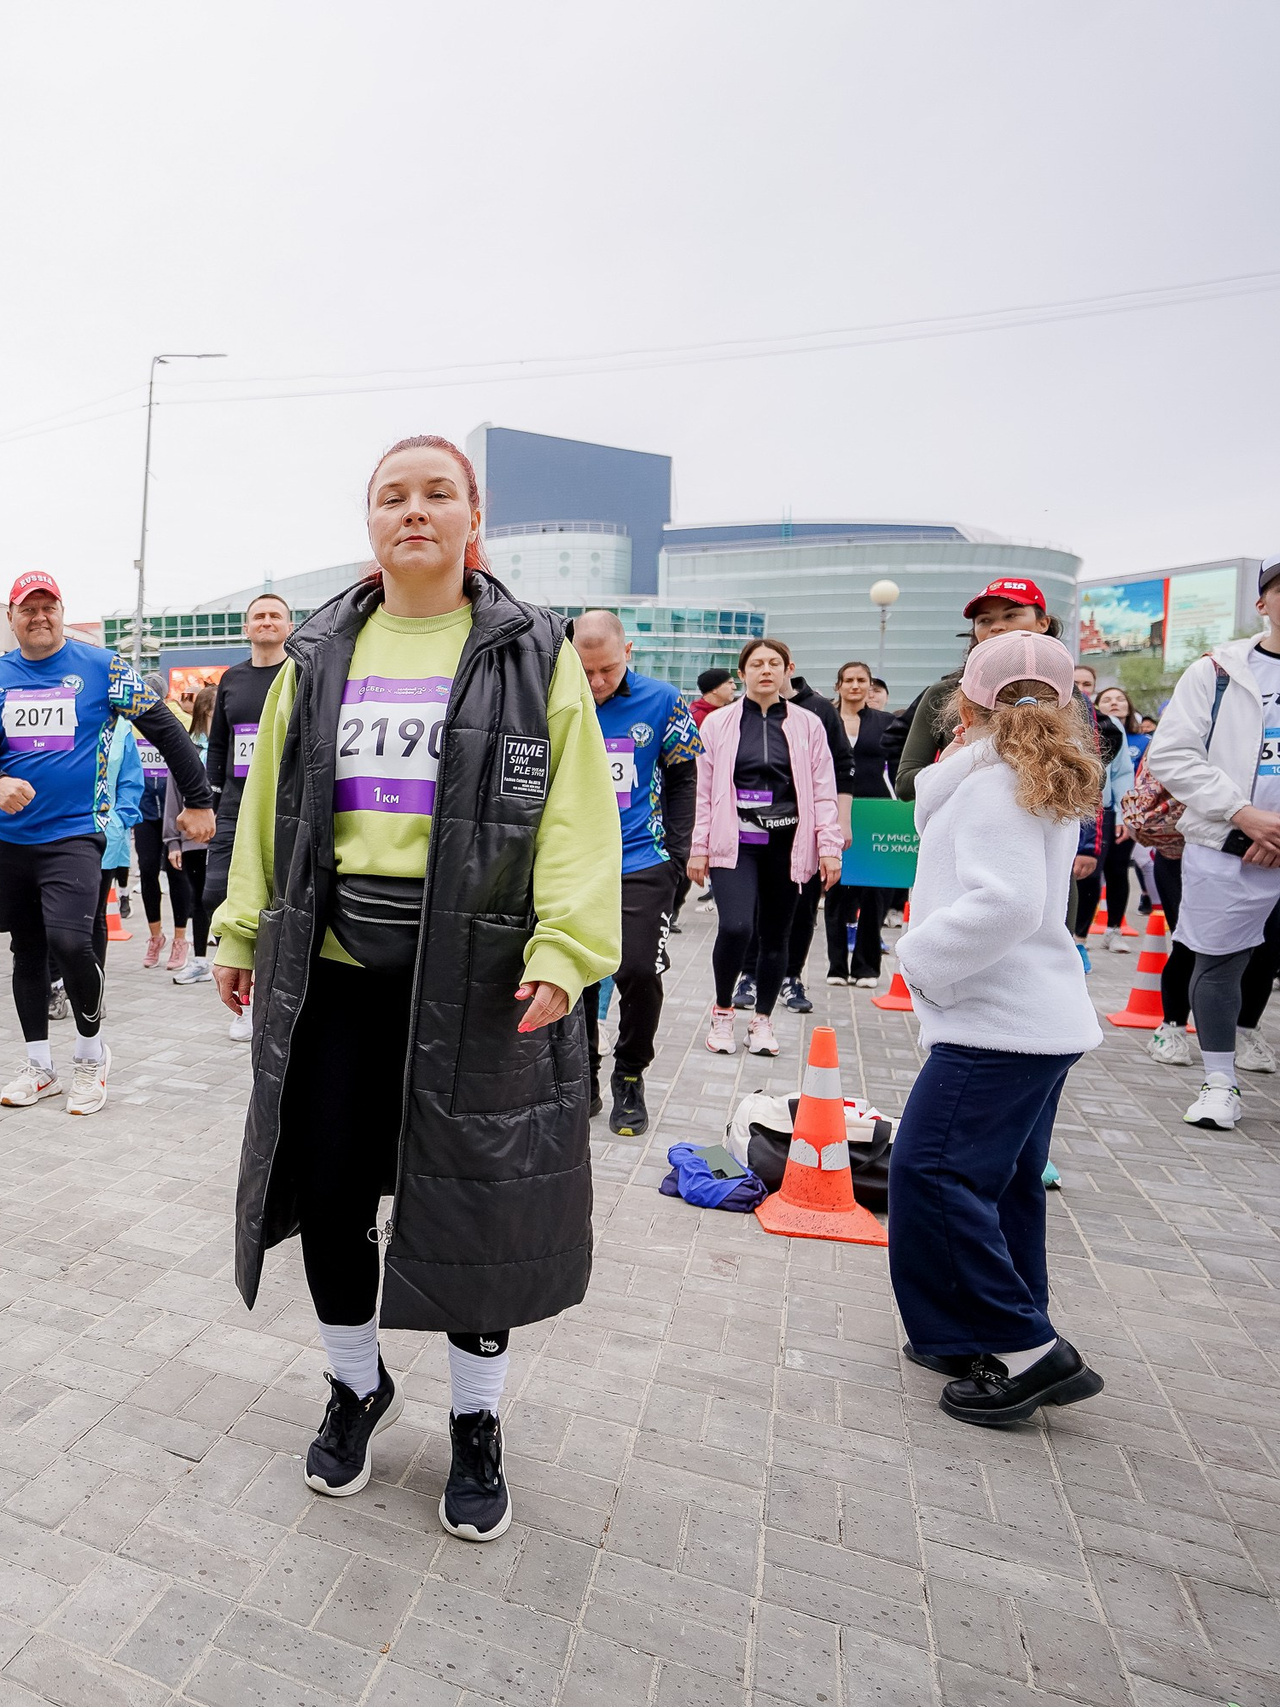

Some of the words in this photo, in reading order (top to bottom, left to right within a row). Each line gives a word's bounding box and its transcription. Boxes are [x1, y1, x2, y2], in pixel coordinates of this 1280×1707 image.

[20, 575, 53, 588] RUSSIA
[15, 708, 64, 727] 2071
[507, 742, 545, 758] TIME
[141, 752, 166, 763] 208
[509, 755, 530, 765] SIM
[513, 765, 531, 775] PLE
[872, 833, 885, 842] ГУ
[887, 833, 911, 843] МЧС
[873, 843, 889, 852] ПО
